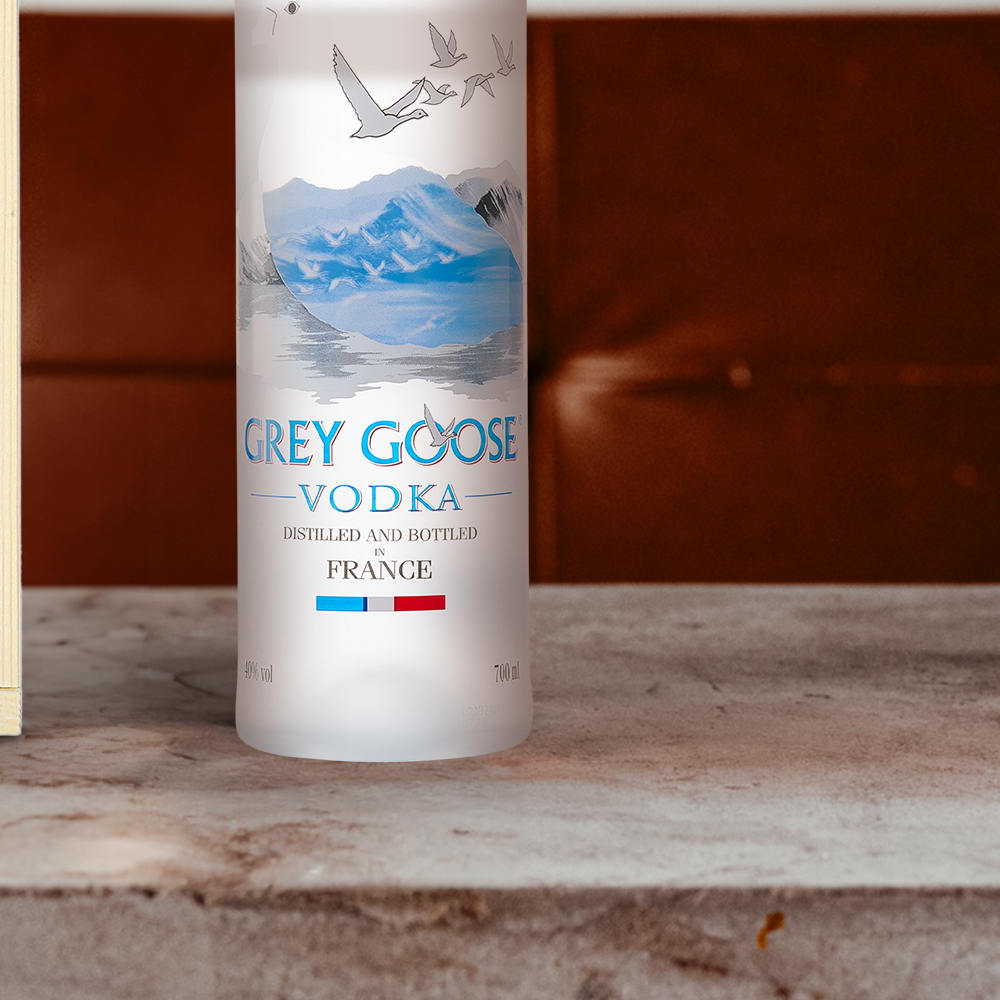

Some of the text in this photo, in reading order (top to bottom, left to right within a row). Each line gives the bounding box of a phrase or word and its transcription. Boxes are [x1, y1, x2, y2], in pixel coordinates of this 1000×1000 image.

[244, 417, 346, 467] GREY
[298, 483, 464, 513] VODKA
[283, 526, 478, 542] DISTILLED AND BOTTLED
[374, 548, 386, 557] IN
[326, 560, 433, 581] FRANCE
[260, 664, 273, 683] vol
[494, 662, 510, 683] 700
